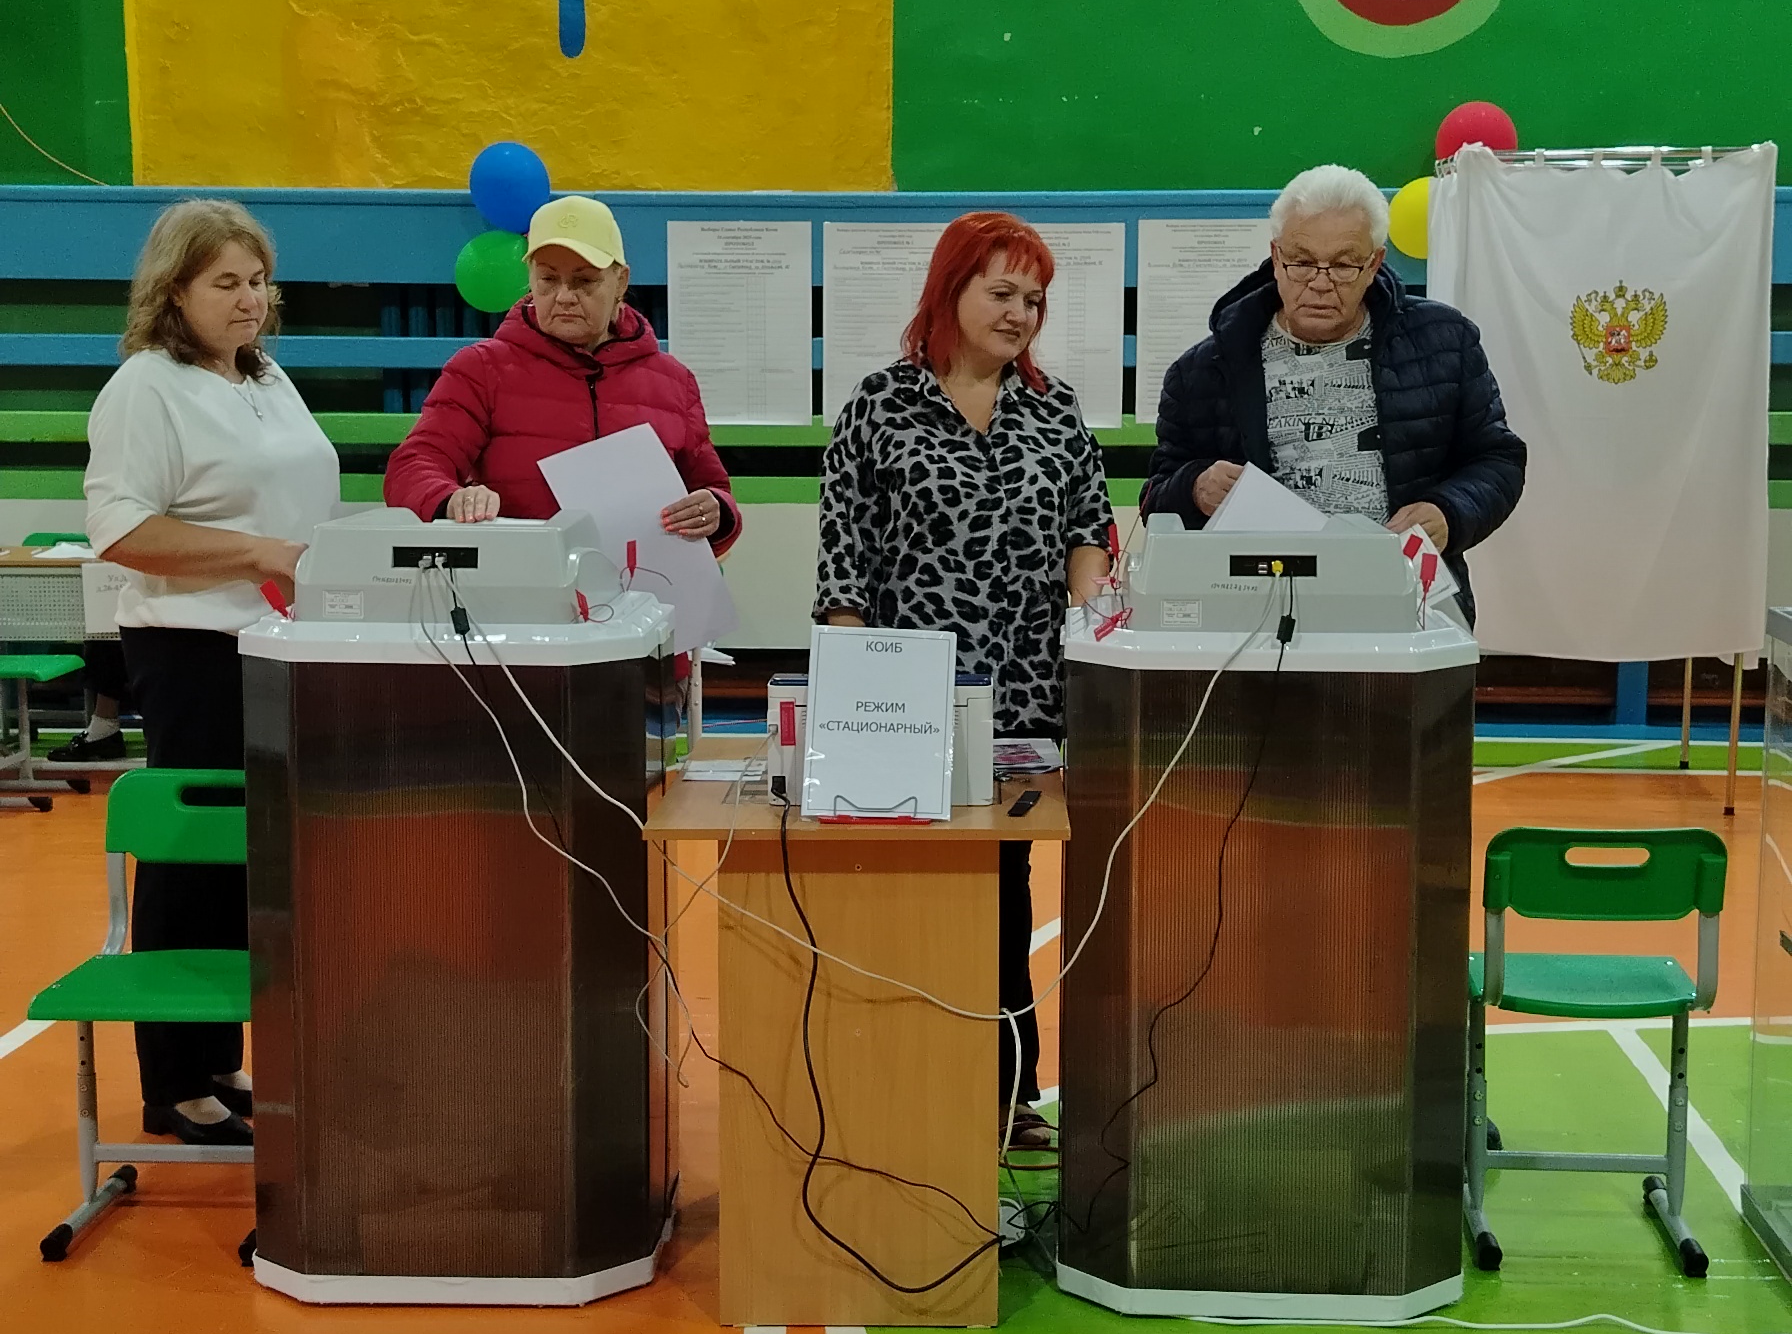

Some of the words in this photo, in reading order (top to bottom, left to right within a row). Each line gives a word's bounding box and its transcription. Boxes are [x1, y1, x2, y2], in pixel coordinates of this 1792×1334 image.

[866, 640, 903, 653] КОИБ
[855, 700, 906, 713] РЕЖИМ
[819, 720, 940, 735] «СТАЦИОНАРНЫЙ»
